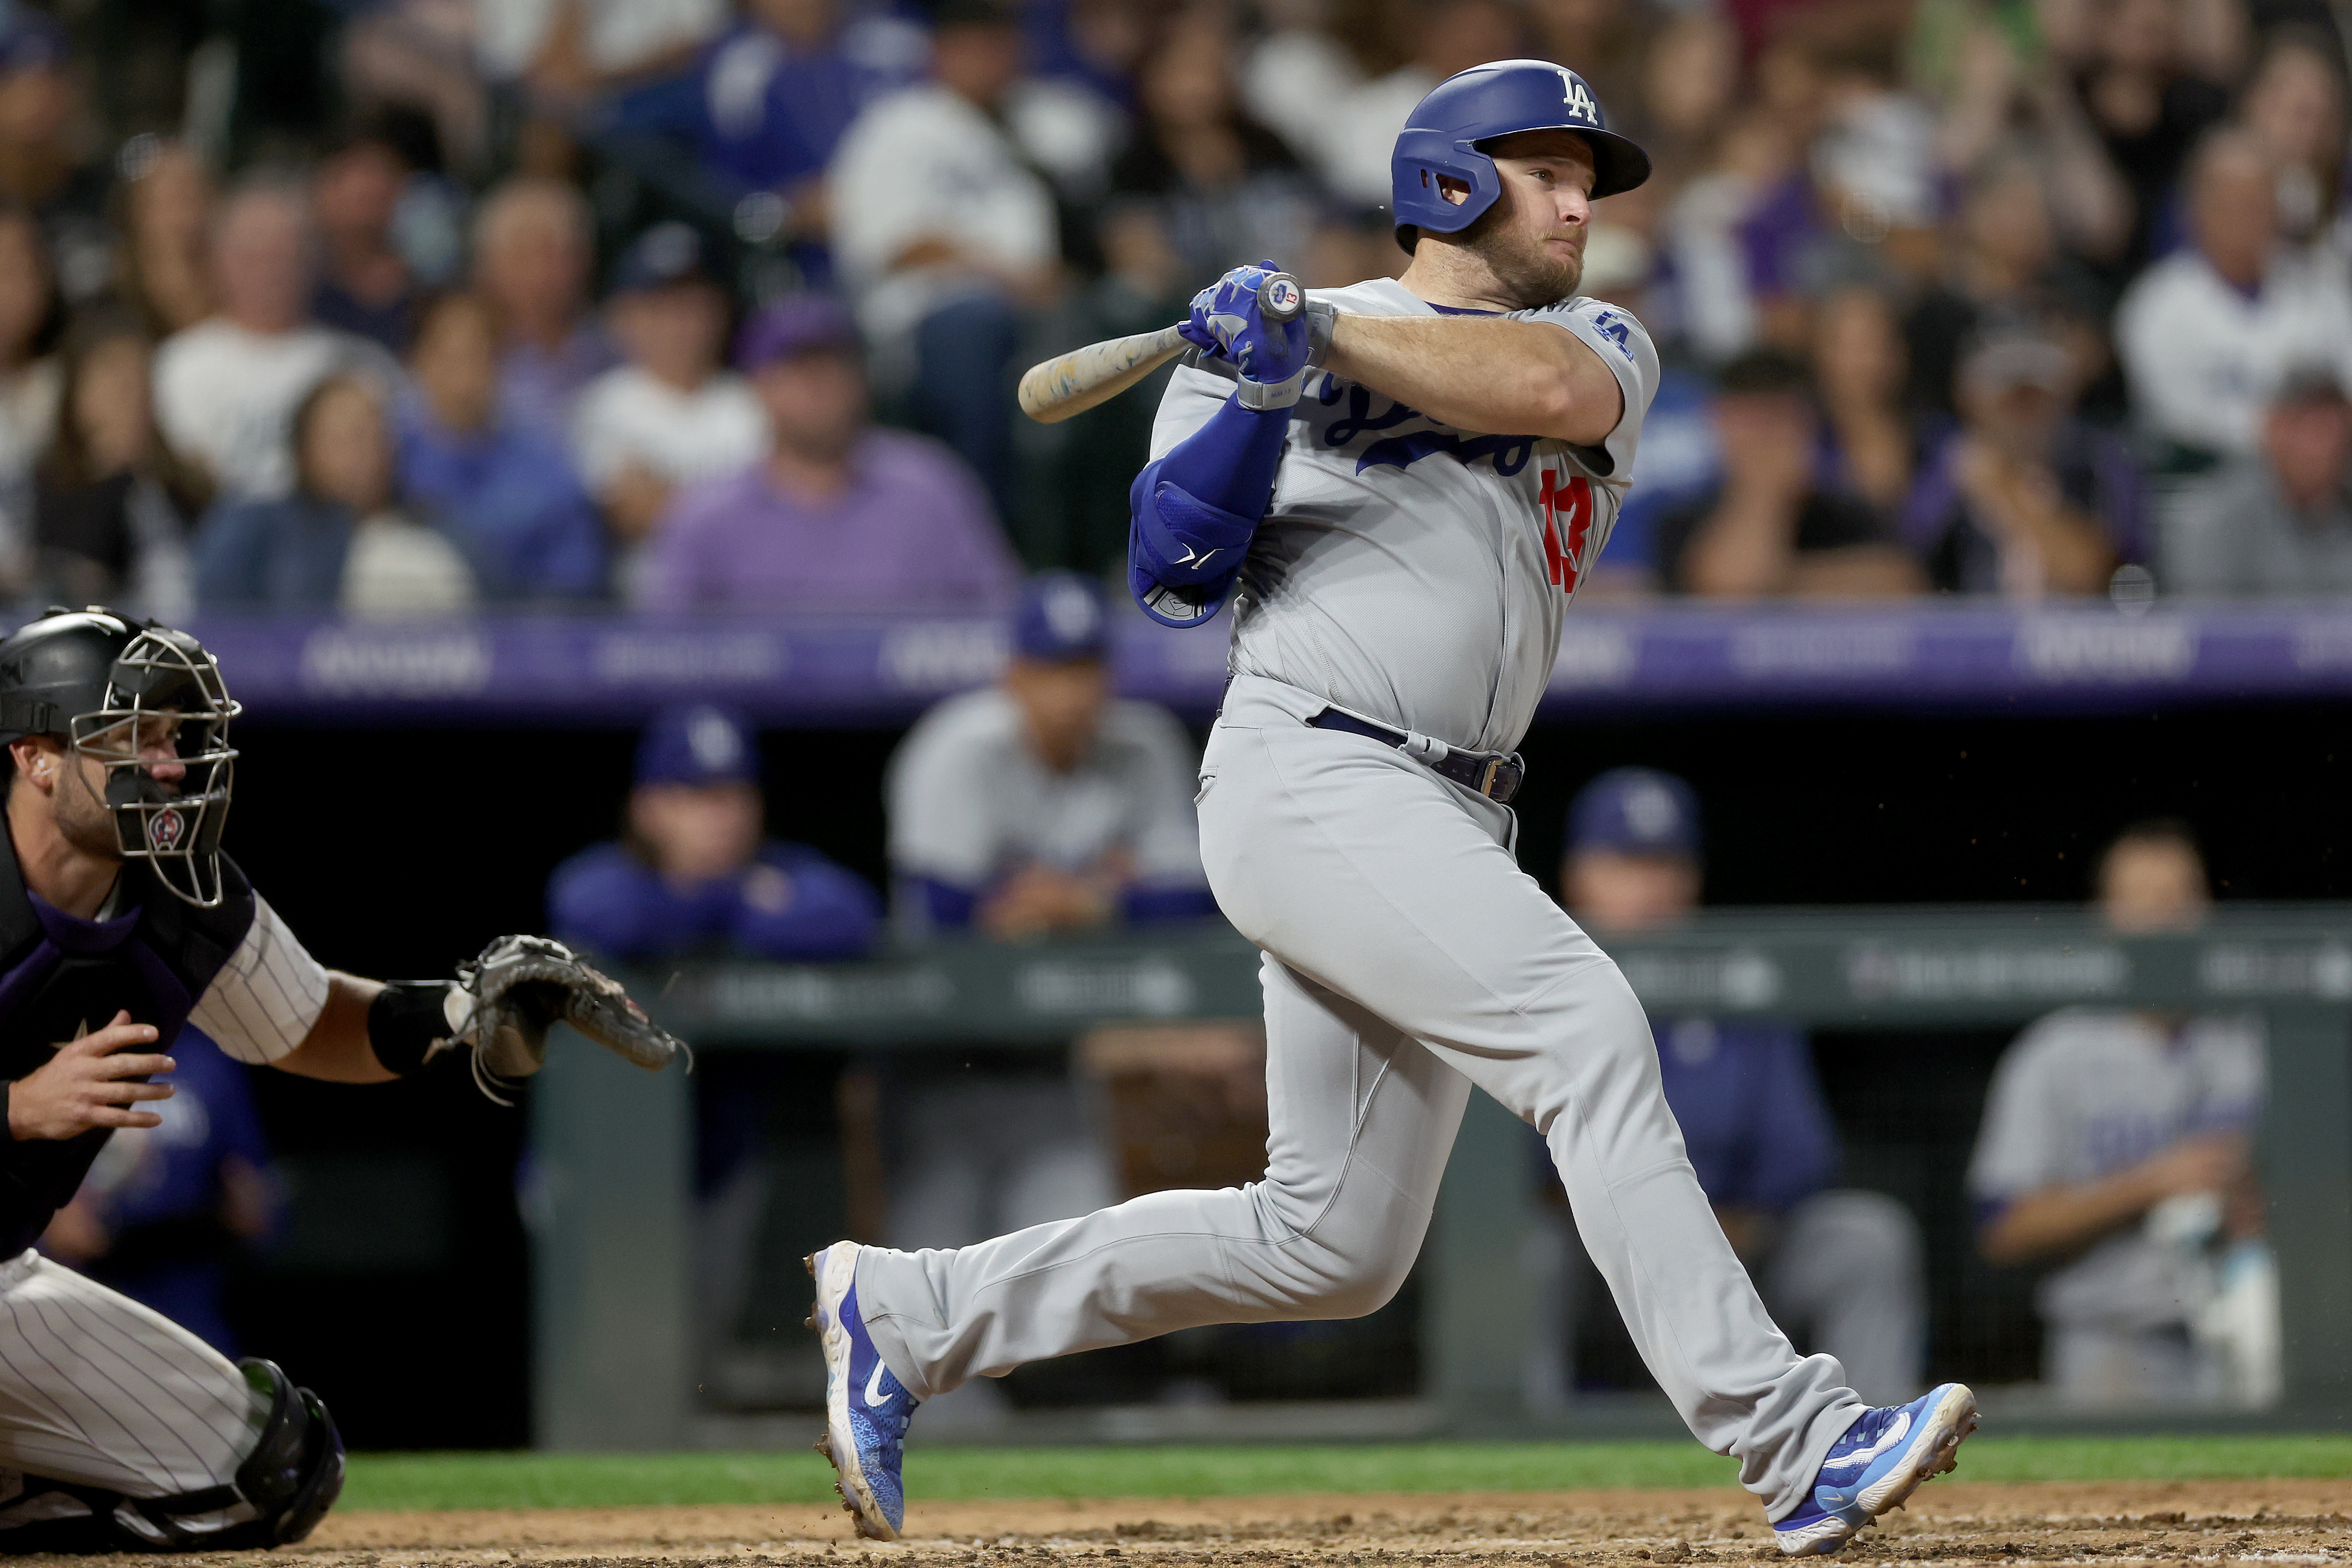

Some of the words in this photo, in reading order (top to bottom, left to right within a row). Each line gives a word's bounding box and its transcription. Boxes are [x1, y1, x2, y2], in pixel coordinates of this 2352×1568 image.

[1557, 70, 1598, 126] LA
[1286, 292, 1298, 304] 13
[1589, 310, 1634, 362] LA
[1539, 469, 1592, 593] 13
